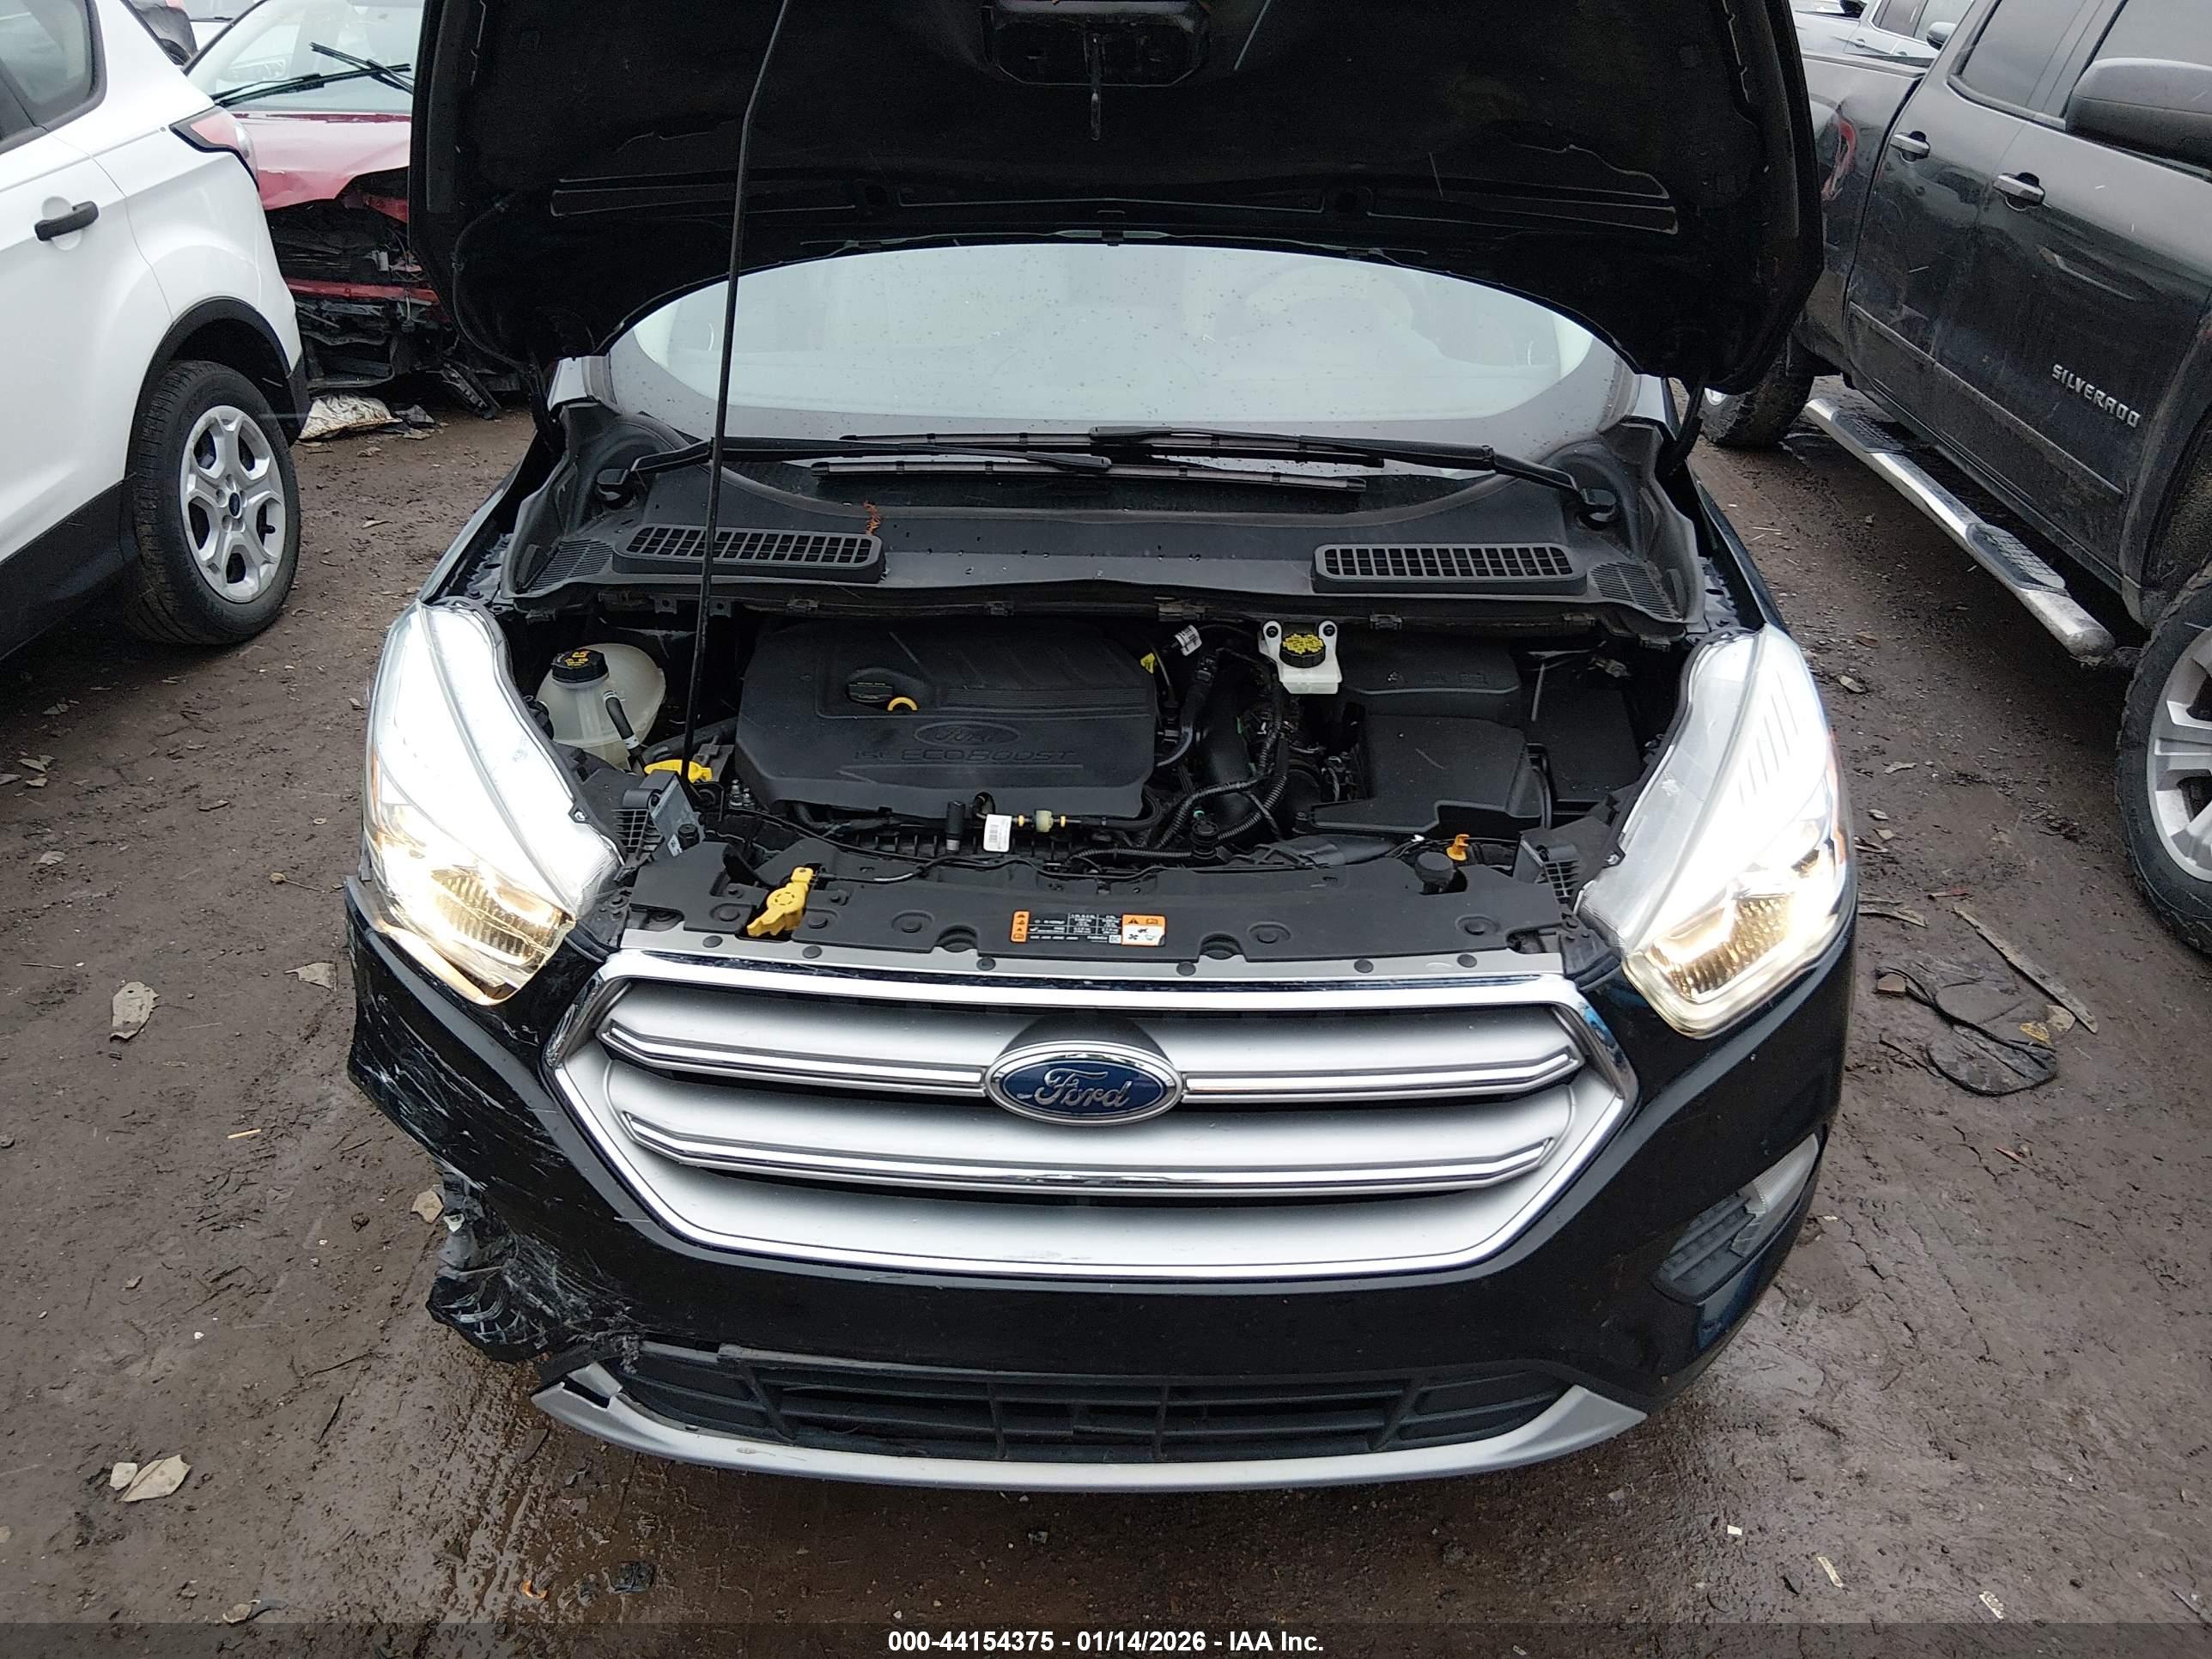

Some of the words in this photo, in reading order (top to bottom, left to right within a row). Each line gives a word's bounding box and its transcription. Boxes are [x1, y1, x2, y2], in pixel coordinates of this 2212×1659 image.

[2051, 364, 2141, 428] SILVERADO
[902, 749, 1077, 762] ECOBOOST
[1017, 1067, 1133, 1108] Ford
